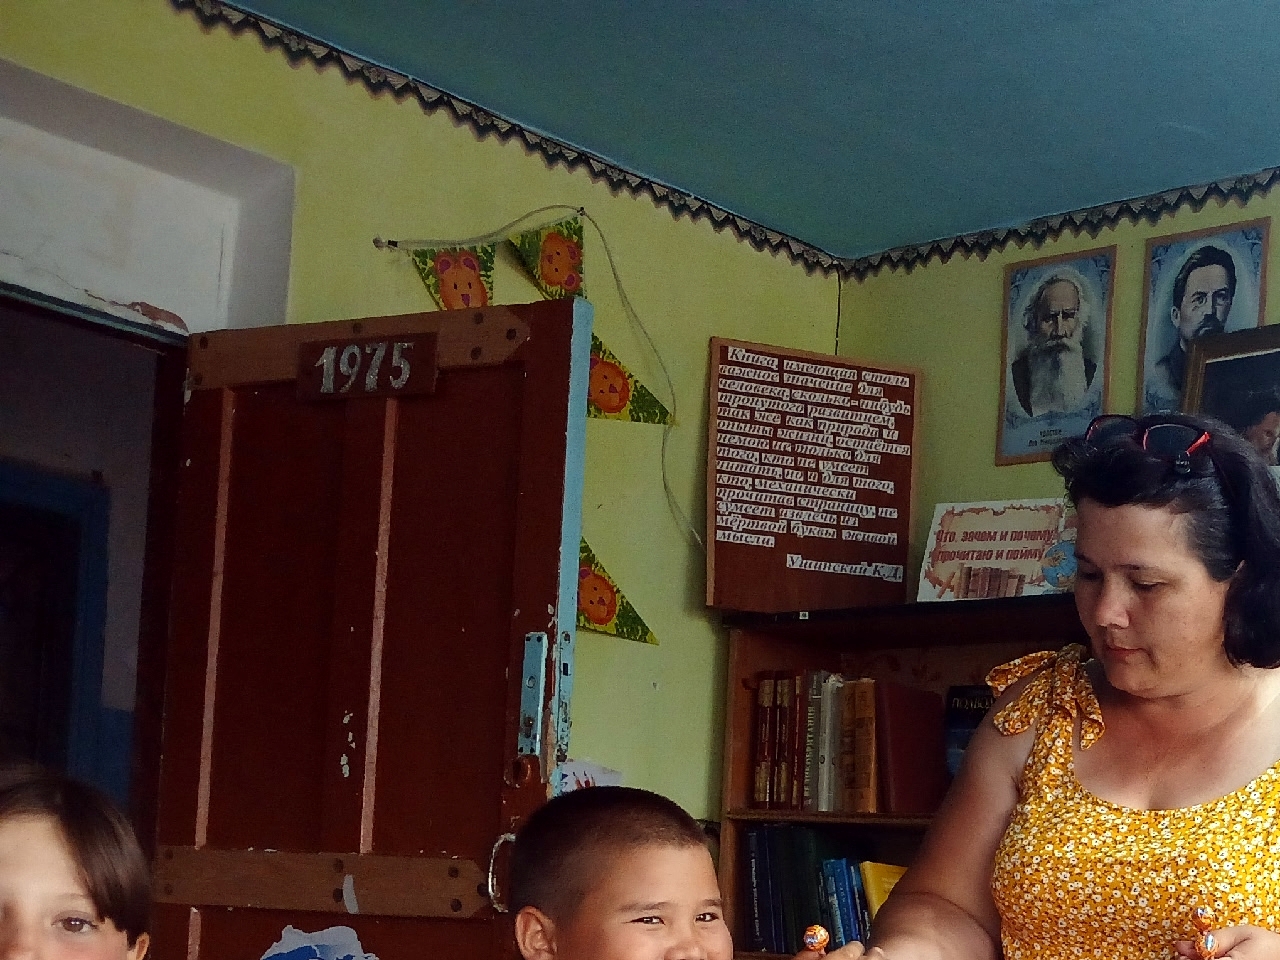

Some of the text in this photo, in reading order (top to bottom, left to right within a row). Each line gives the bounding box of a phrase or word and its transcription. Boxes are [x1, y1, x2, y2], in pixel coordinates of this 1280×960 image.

[314, 341, 415, 394] 1975
[728, 348, 909, 388] Книга, имеющая столь
[787, 554, 868, 575] Ушинский
